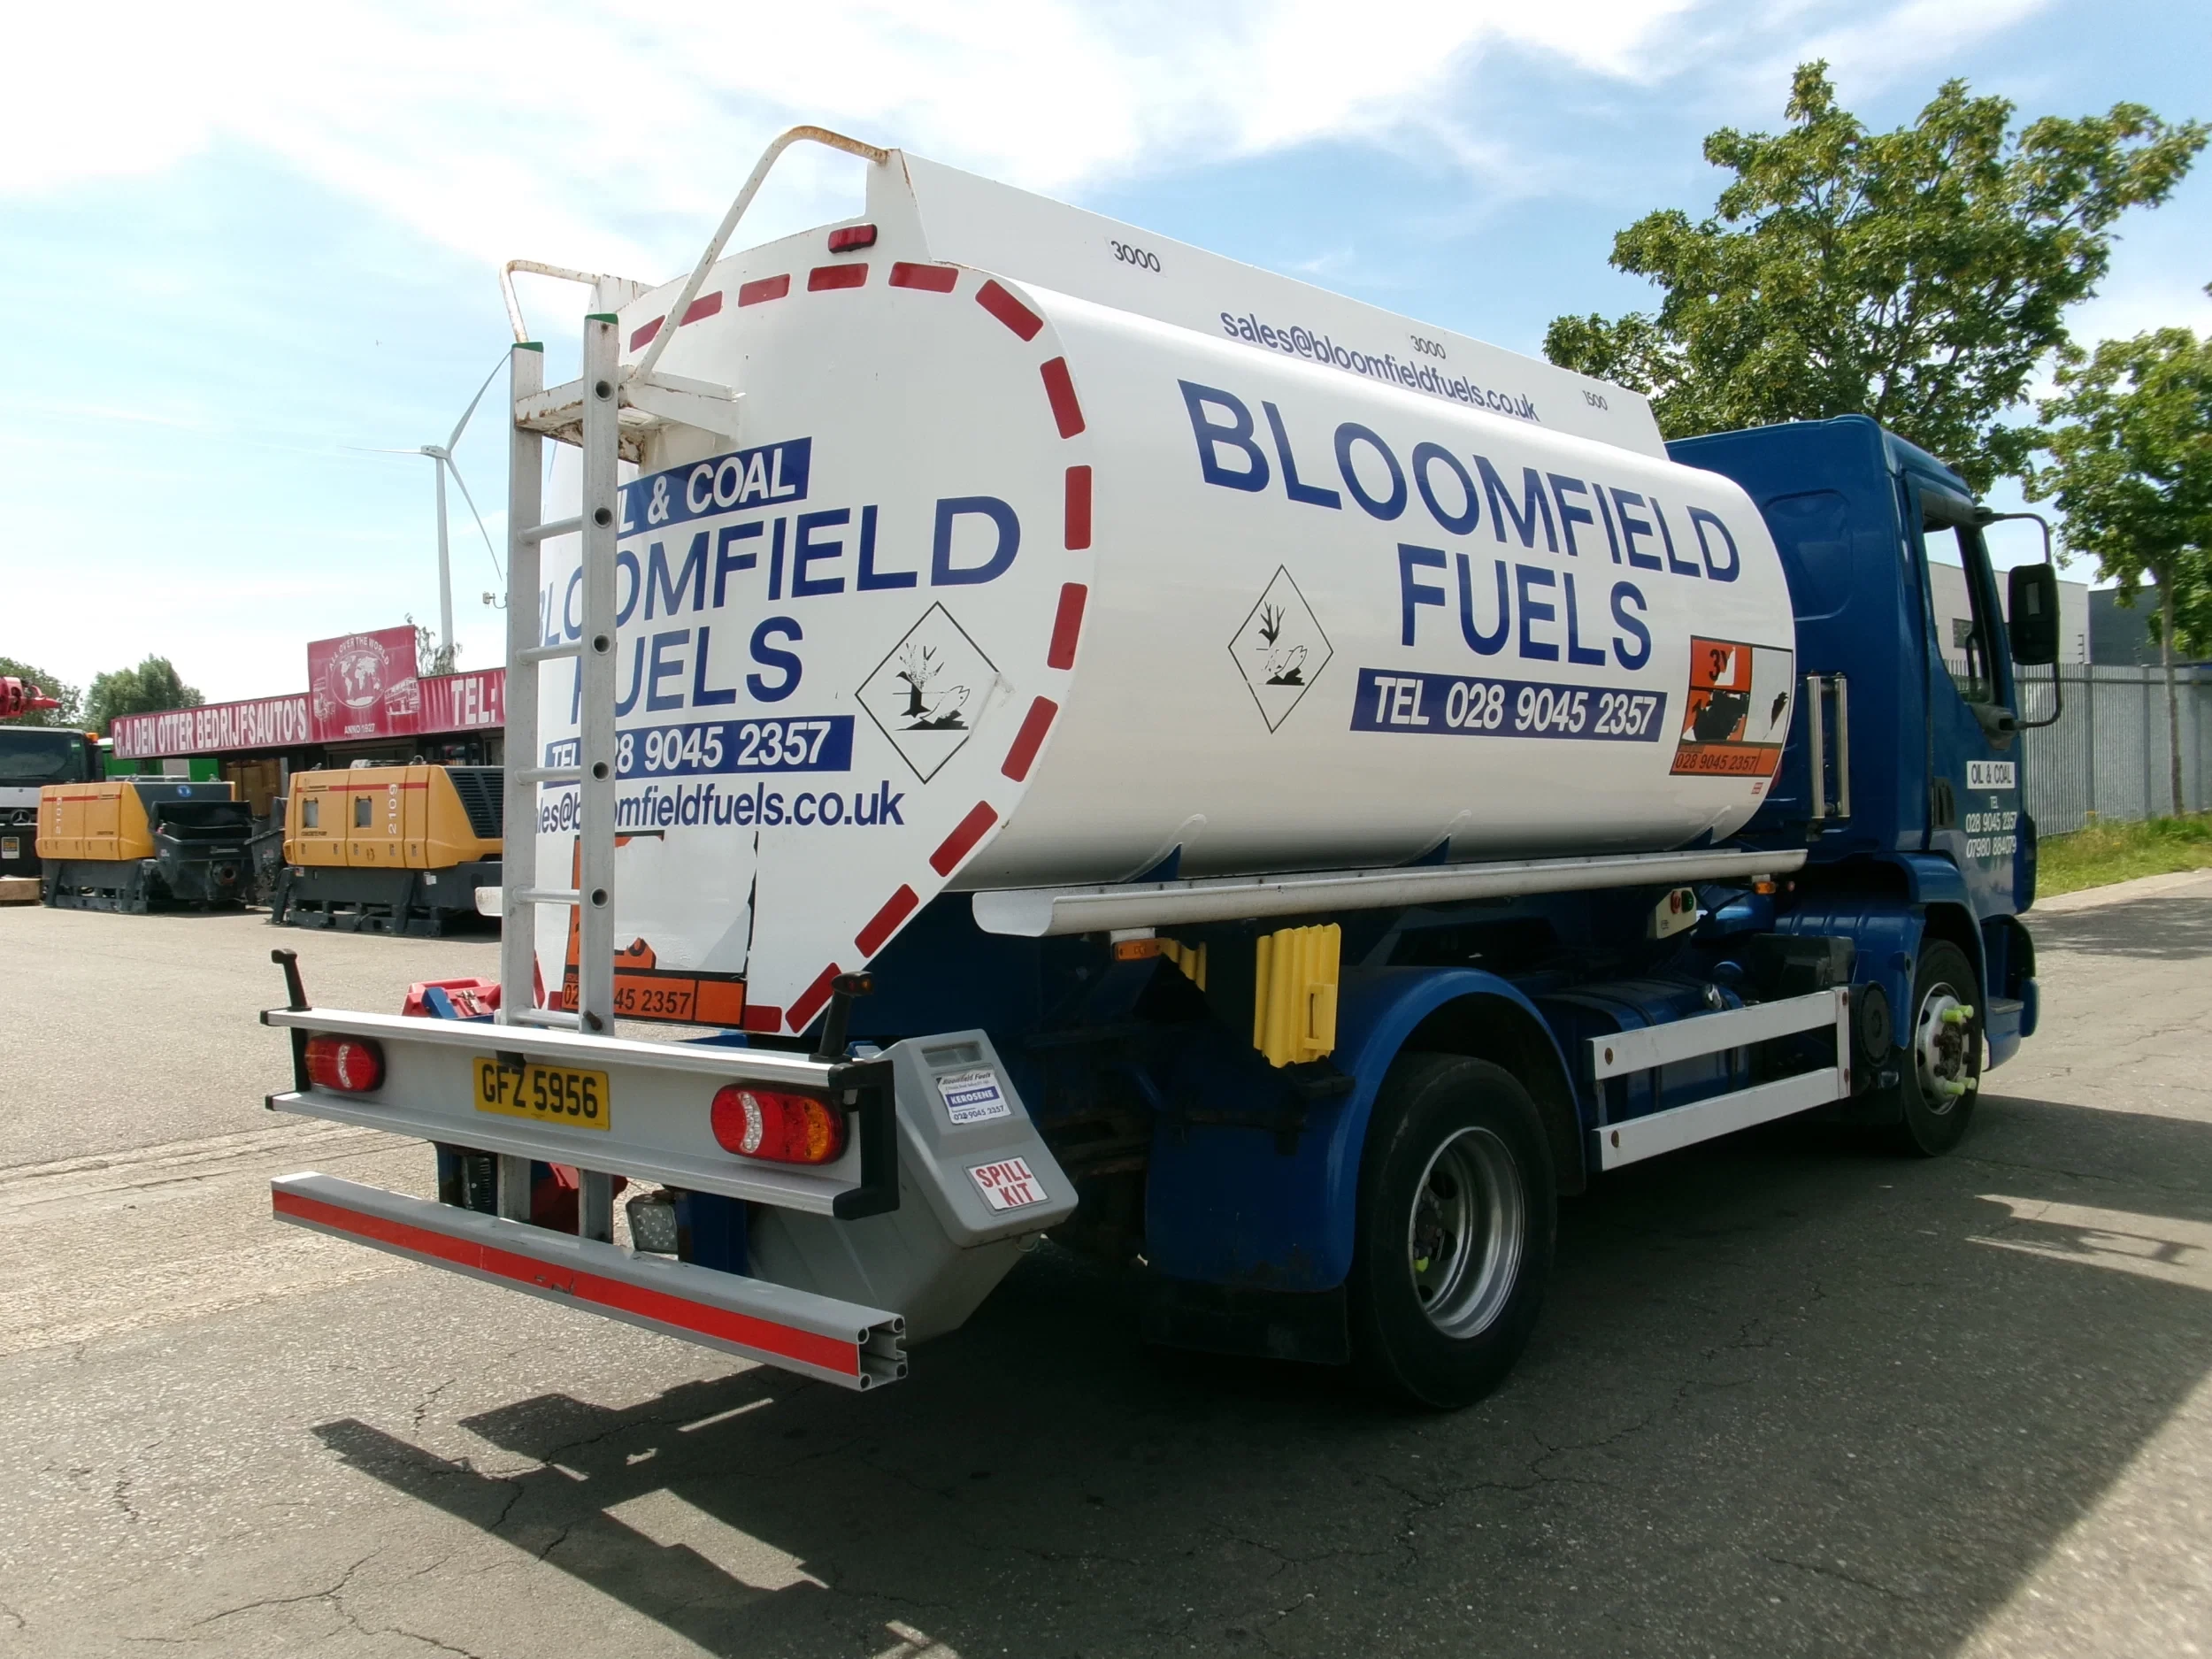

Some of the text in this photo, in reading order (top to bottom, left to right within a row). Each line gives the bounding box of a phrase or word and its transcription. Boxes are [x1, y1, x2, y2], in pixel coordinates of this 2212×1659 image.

[1110, 241, 1161, 273] 3000
[1410, 334, 1447, 359] 3000
[1220, 311, 1540, 422] sales@bloomfieldfuels.co.uk
[1582, 390, 1608, 411] 1500
[648, 475, 670, 524] &
[686, 448, 795, 514] COAL
[1177, 379, 1740, 583] BLOOMFIELD
[1397, 542, 1652, 672] FUELS
[329, 637, 389, 672] ALL OVER THE WORLD
[451, 677, 495, 726] TEL:
[1373, 676, 1657, 737] TEL 028 9045 2357
[134, 718, 156, 755] DEN
[157, 711, 195, 752] OTTER
[196, 698, 307, 749] BEDRIJFSAUTO'S
[344, 725, 361, 734] ANNO
[644, 726, 724, 772] 9045
[736, 721, 832, 766] 2357
[1675, 754, 1757, 771] 028 9045 2357
[1971, 764, 2012, 784] OIL & COAL
[388, 783, 398, 834] 2109
[1966, 813, 1981, 833] 028
[1983, 812, 2001, 832] 9045
[565, 982, 692, 1015] 02 45 2357
[481, 1064, 598, 1118] GFZ 5956
[950, 1089, 994, 1104] KEROSENE
[968, 1109, 987, 1118] 9045
[987, 1105, 1004, 1114] 2357
[975, 1160, 1032, 1188] SPILL
[998, 1183, 1034, 1206] KIT
